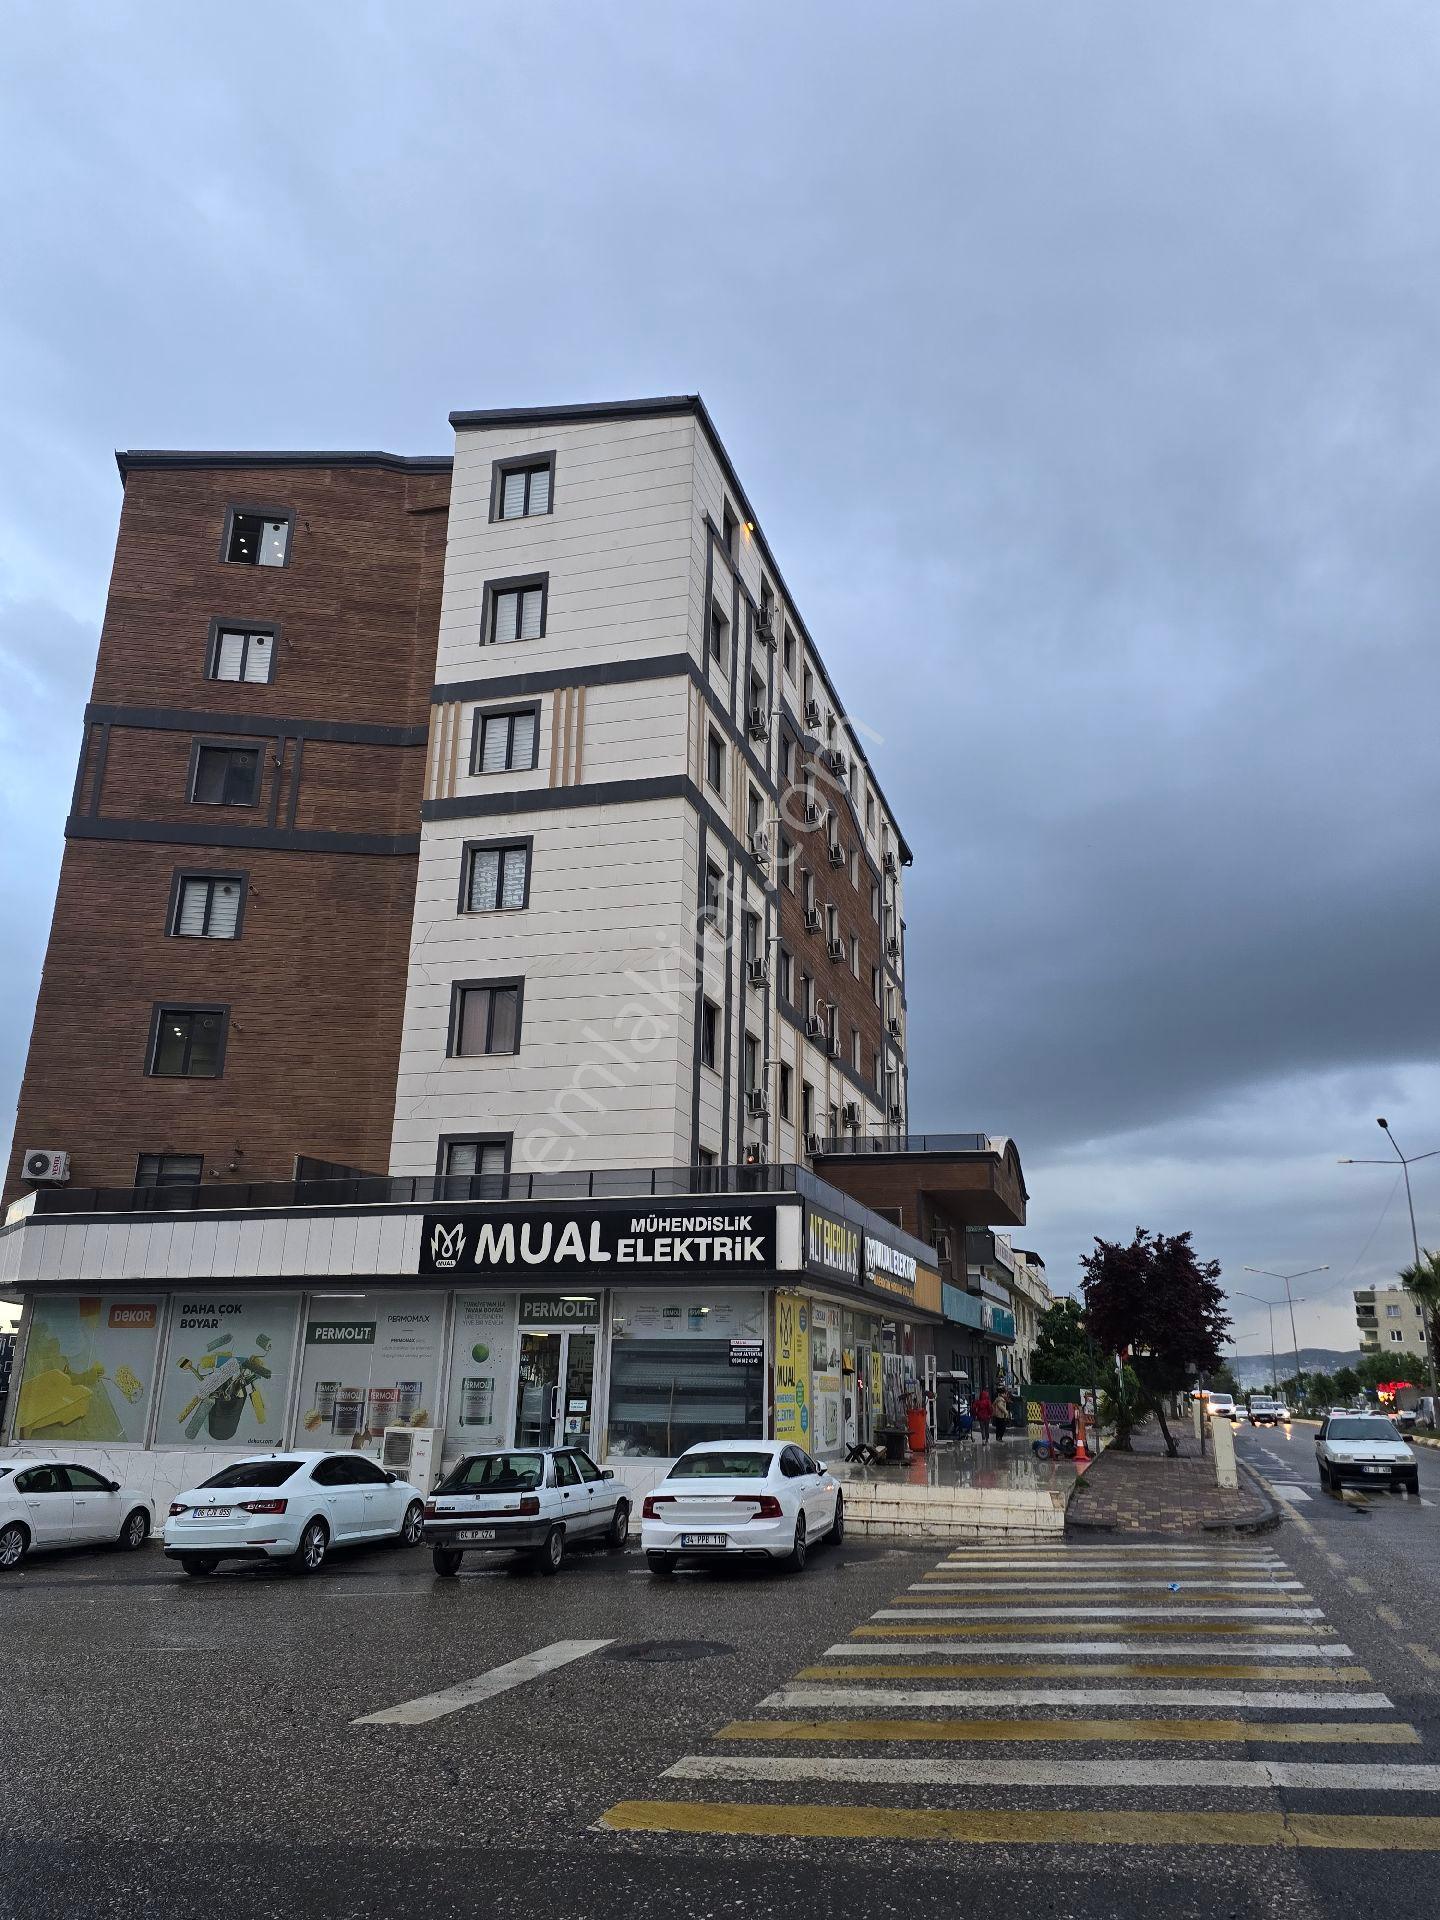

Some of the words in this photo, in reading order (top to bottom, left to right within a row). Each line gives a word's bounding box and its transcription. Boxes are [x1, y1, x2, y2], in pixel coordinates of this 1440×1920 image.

[473, 1220, 612, 1265] MUAL
[182, 1304, 216, 1314] DAHA
[218, 1304, 243, 1316] ÇOK
[180, 1318, 220, 1329] BOYAR
[387, 1315, 431, 1323] PERMOMAX
[777, 1366, 796, 1387] MUAL
[685, 1535, 694, 1544] 34
[713, 1535, 725, 1544] 110
